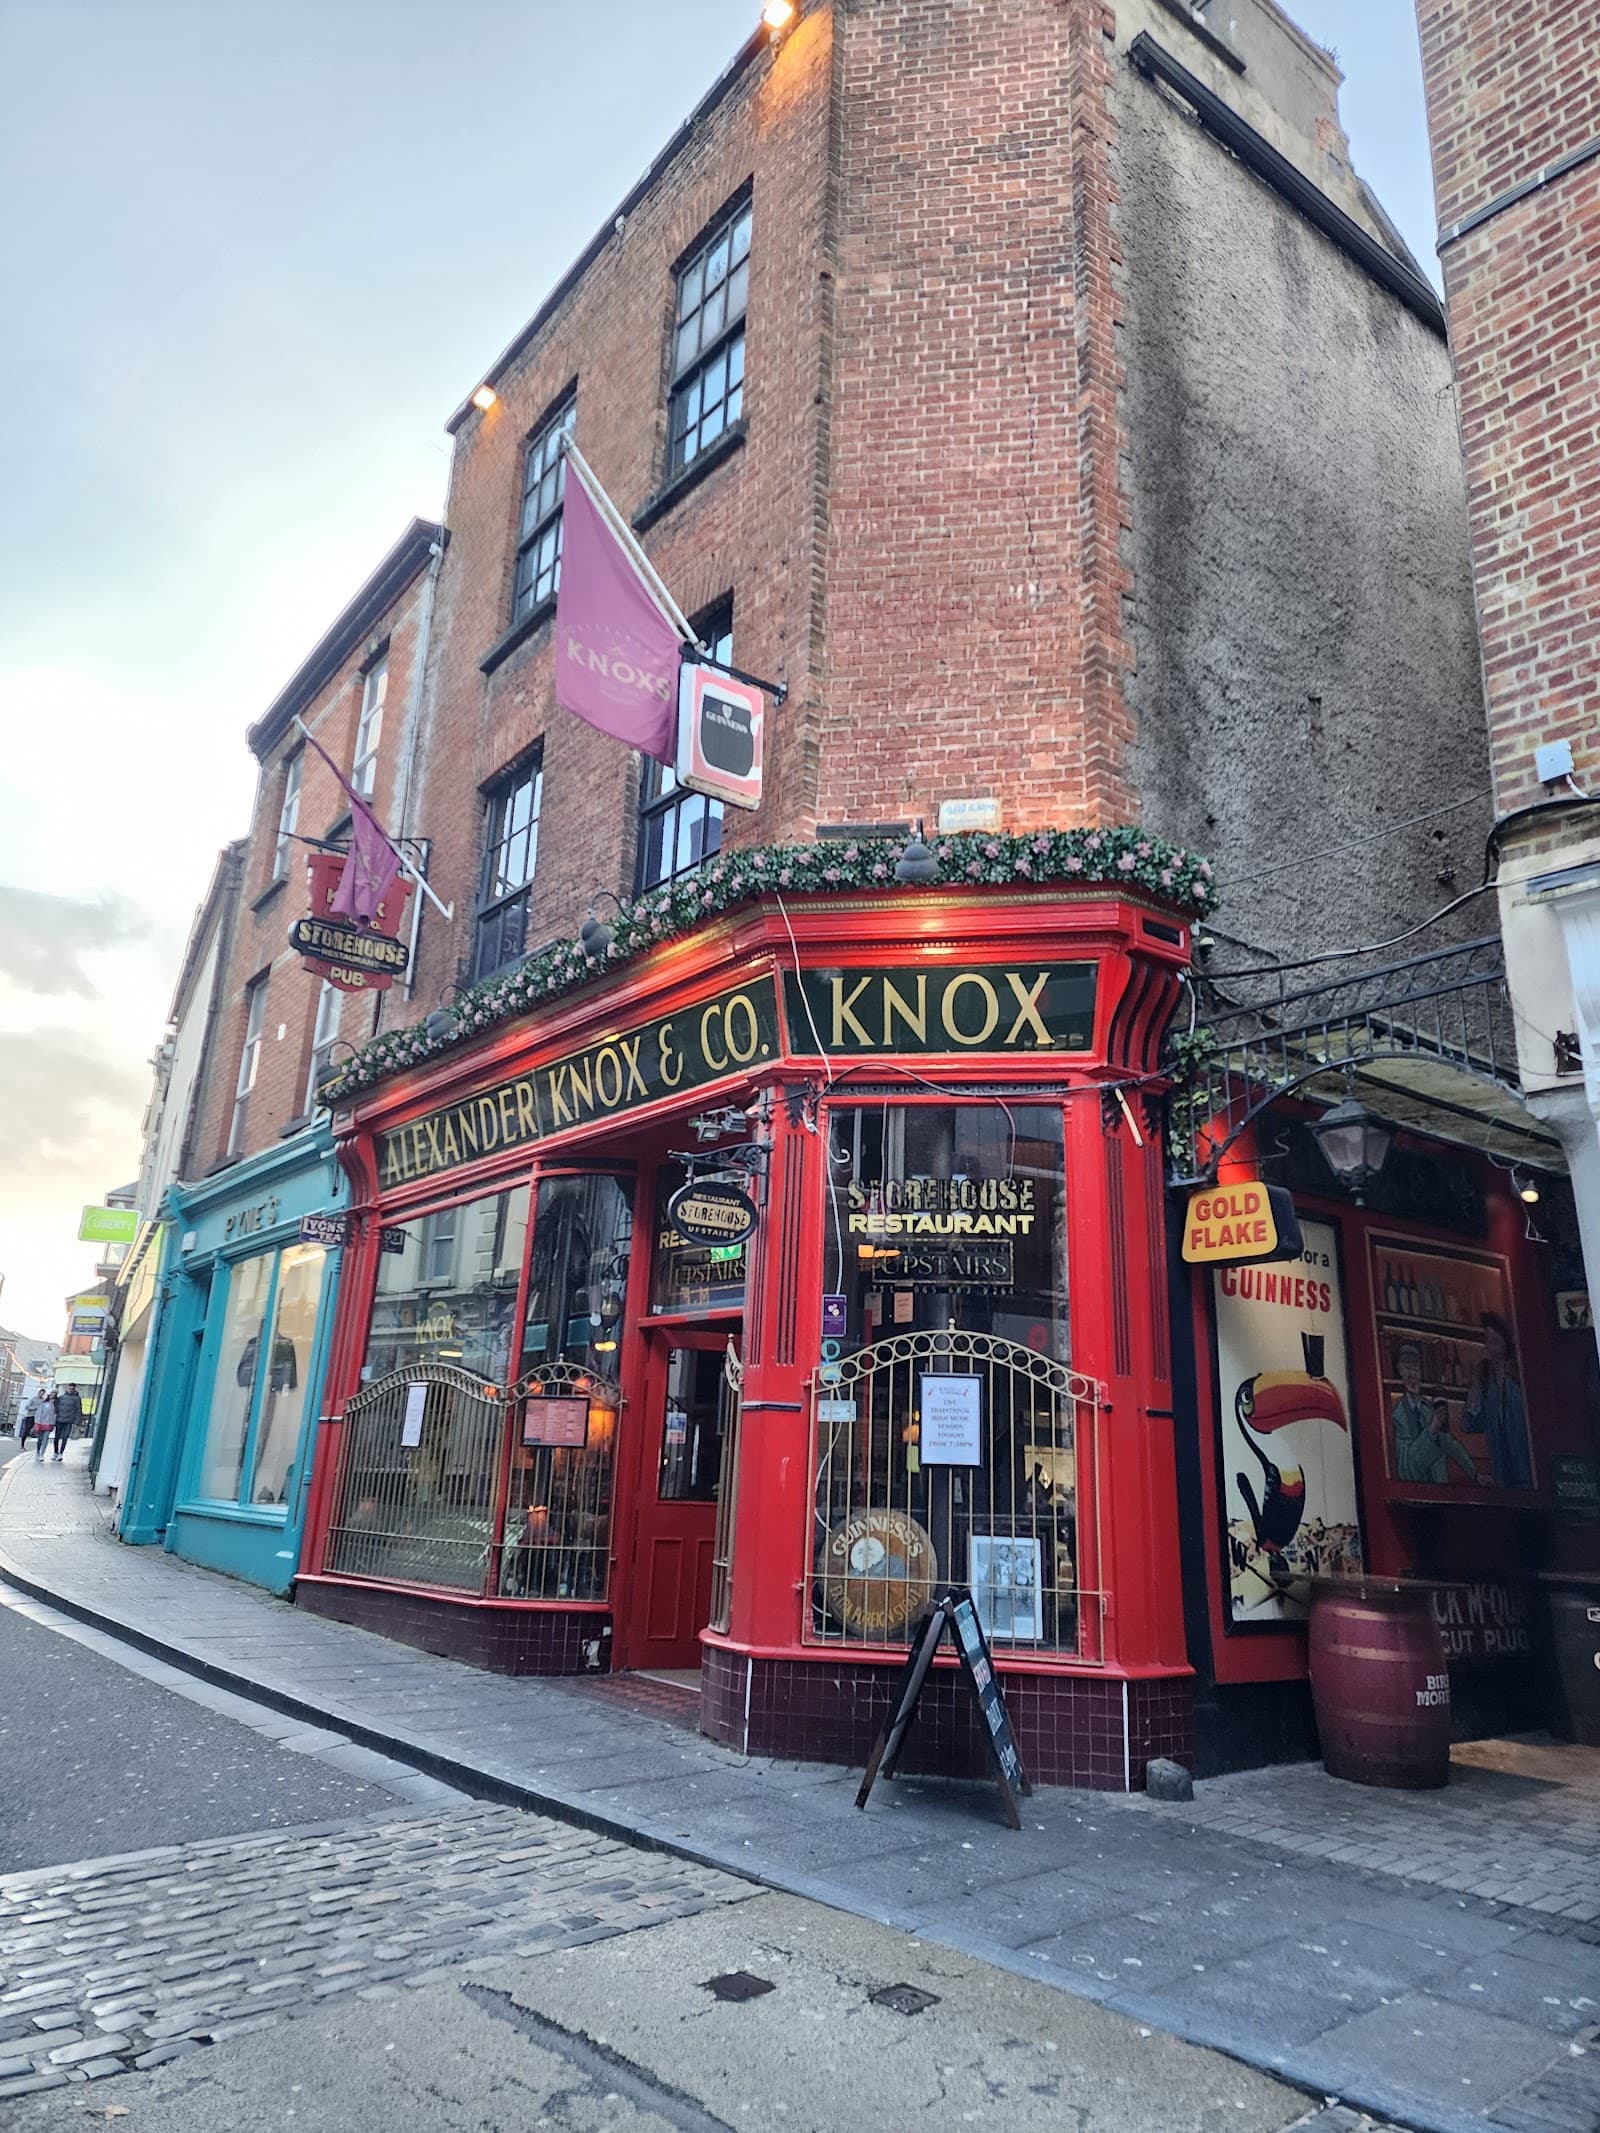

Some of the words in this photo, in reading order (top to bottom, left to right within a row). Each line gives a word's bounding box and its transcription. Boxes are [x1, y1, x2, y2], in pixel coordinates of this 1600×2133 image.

[567, 638, 671, 701] KNOXS
[299, 921, 407, 967] STOREHOUSE
[329, 966, 365, 987] PUB
[830, 972, 1056, 1047] KNOX
[386, 1081, 538, 1185] ALEXANDER
[548, 1036, 649, 1127] KNOX
[658, 1023, 683, 1087] &
[700, 994, 770, 1071] CO.
[847, 1178, 1035, 1211] STOREHOUSE
[1195, 1193, 1261, 1222] GOLD
[301, 1217, 346, 1234] LYONS
[680, 1204, 746, 1228] STOREHOUSE
[849, 1213, 1035, 1234] RESTAURANT
[1191, 1220, 1267, 1249] FLAKE
[881, 1254, 1007, 1276] UPSTAIRS
[1220, 1267, 1331, 1313] GUINNESS
